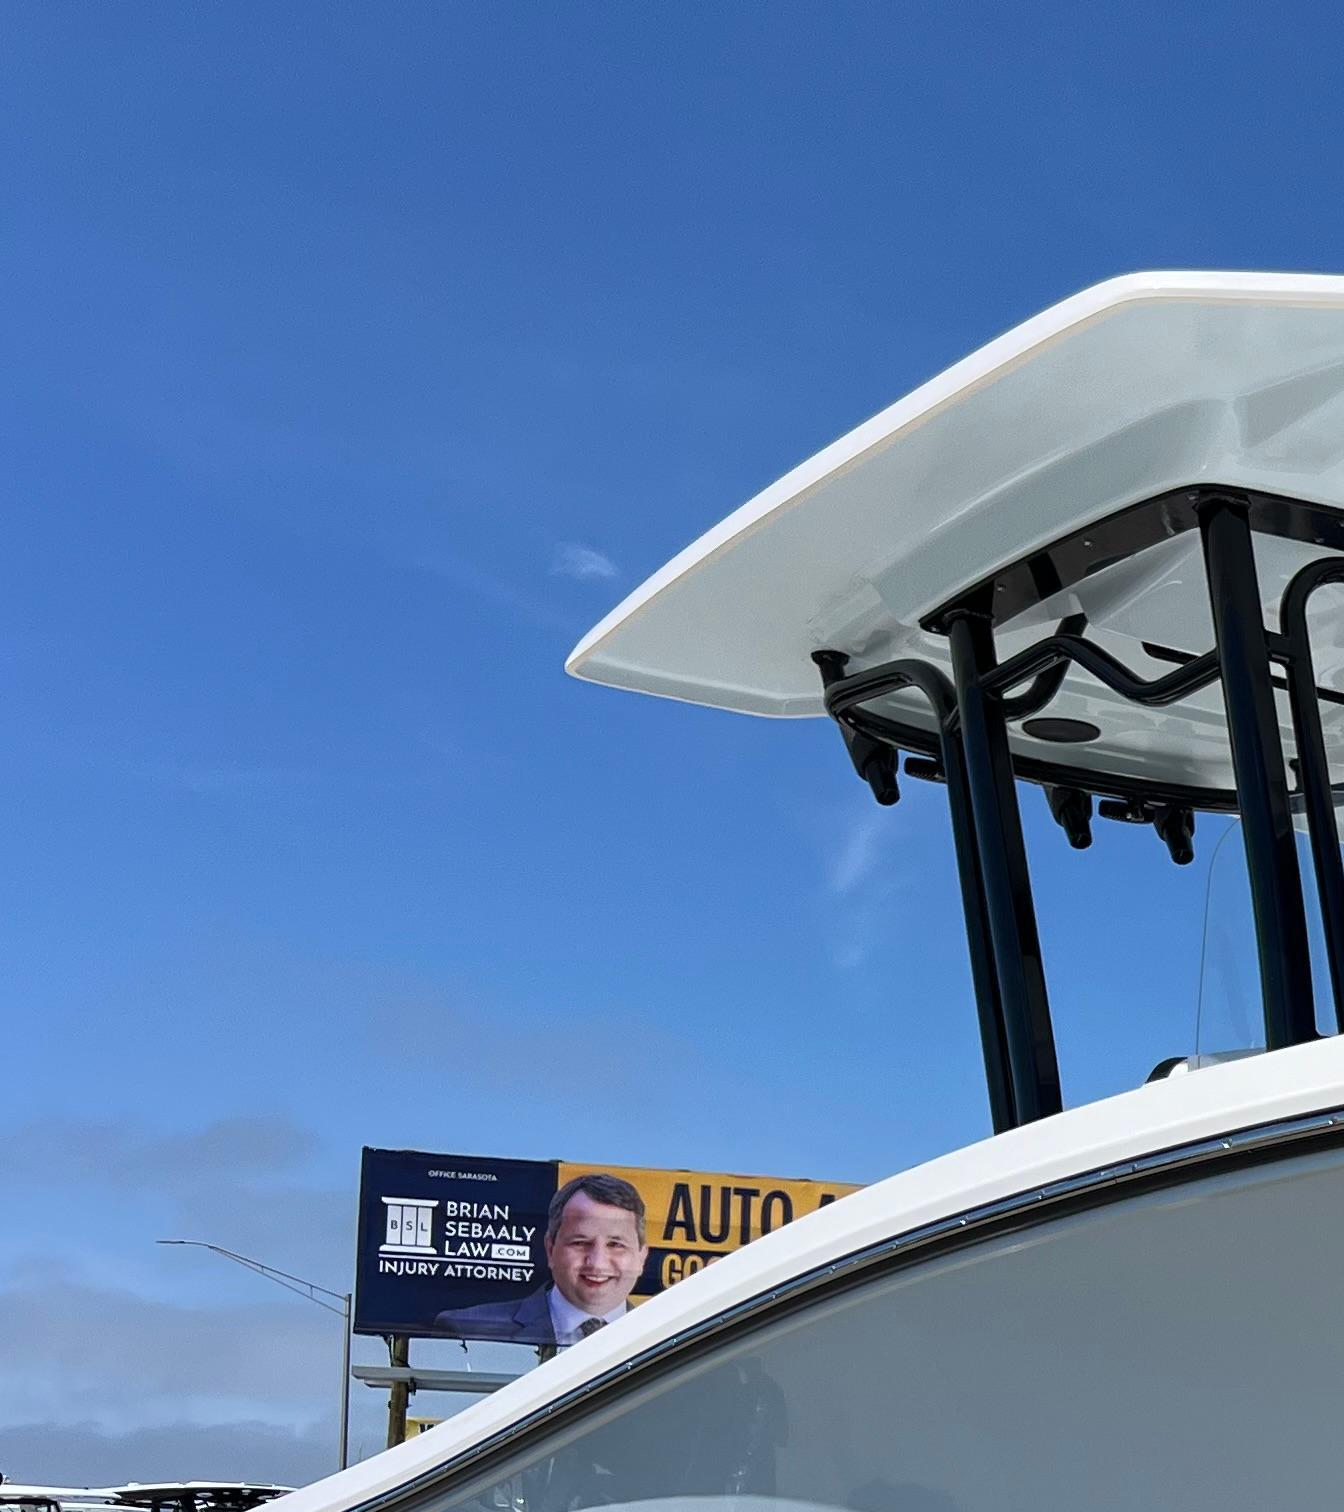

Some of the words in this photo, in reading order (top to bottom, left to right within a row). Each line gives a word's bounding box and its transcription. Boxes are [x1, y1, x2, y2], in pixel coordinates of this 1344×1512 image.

[428, 1170, 456, 1179] OFFICE
[458, 1172, 497, 1181] SARASOTA
[447, 1201, 509, 1220] BRIAN
[663, 1183, 793, 1245] AUTO
[445, 1221, 536, 1241] SEBAALY
[445, 1240, 489, 1257] LAW
[379, 1260, 439, 1276] INJURY
[444, 1264, 534, 1282] ATTORNEY
[661, 1253, 724, 1288] GO
